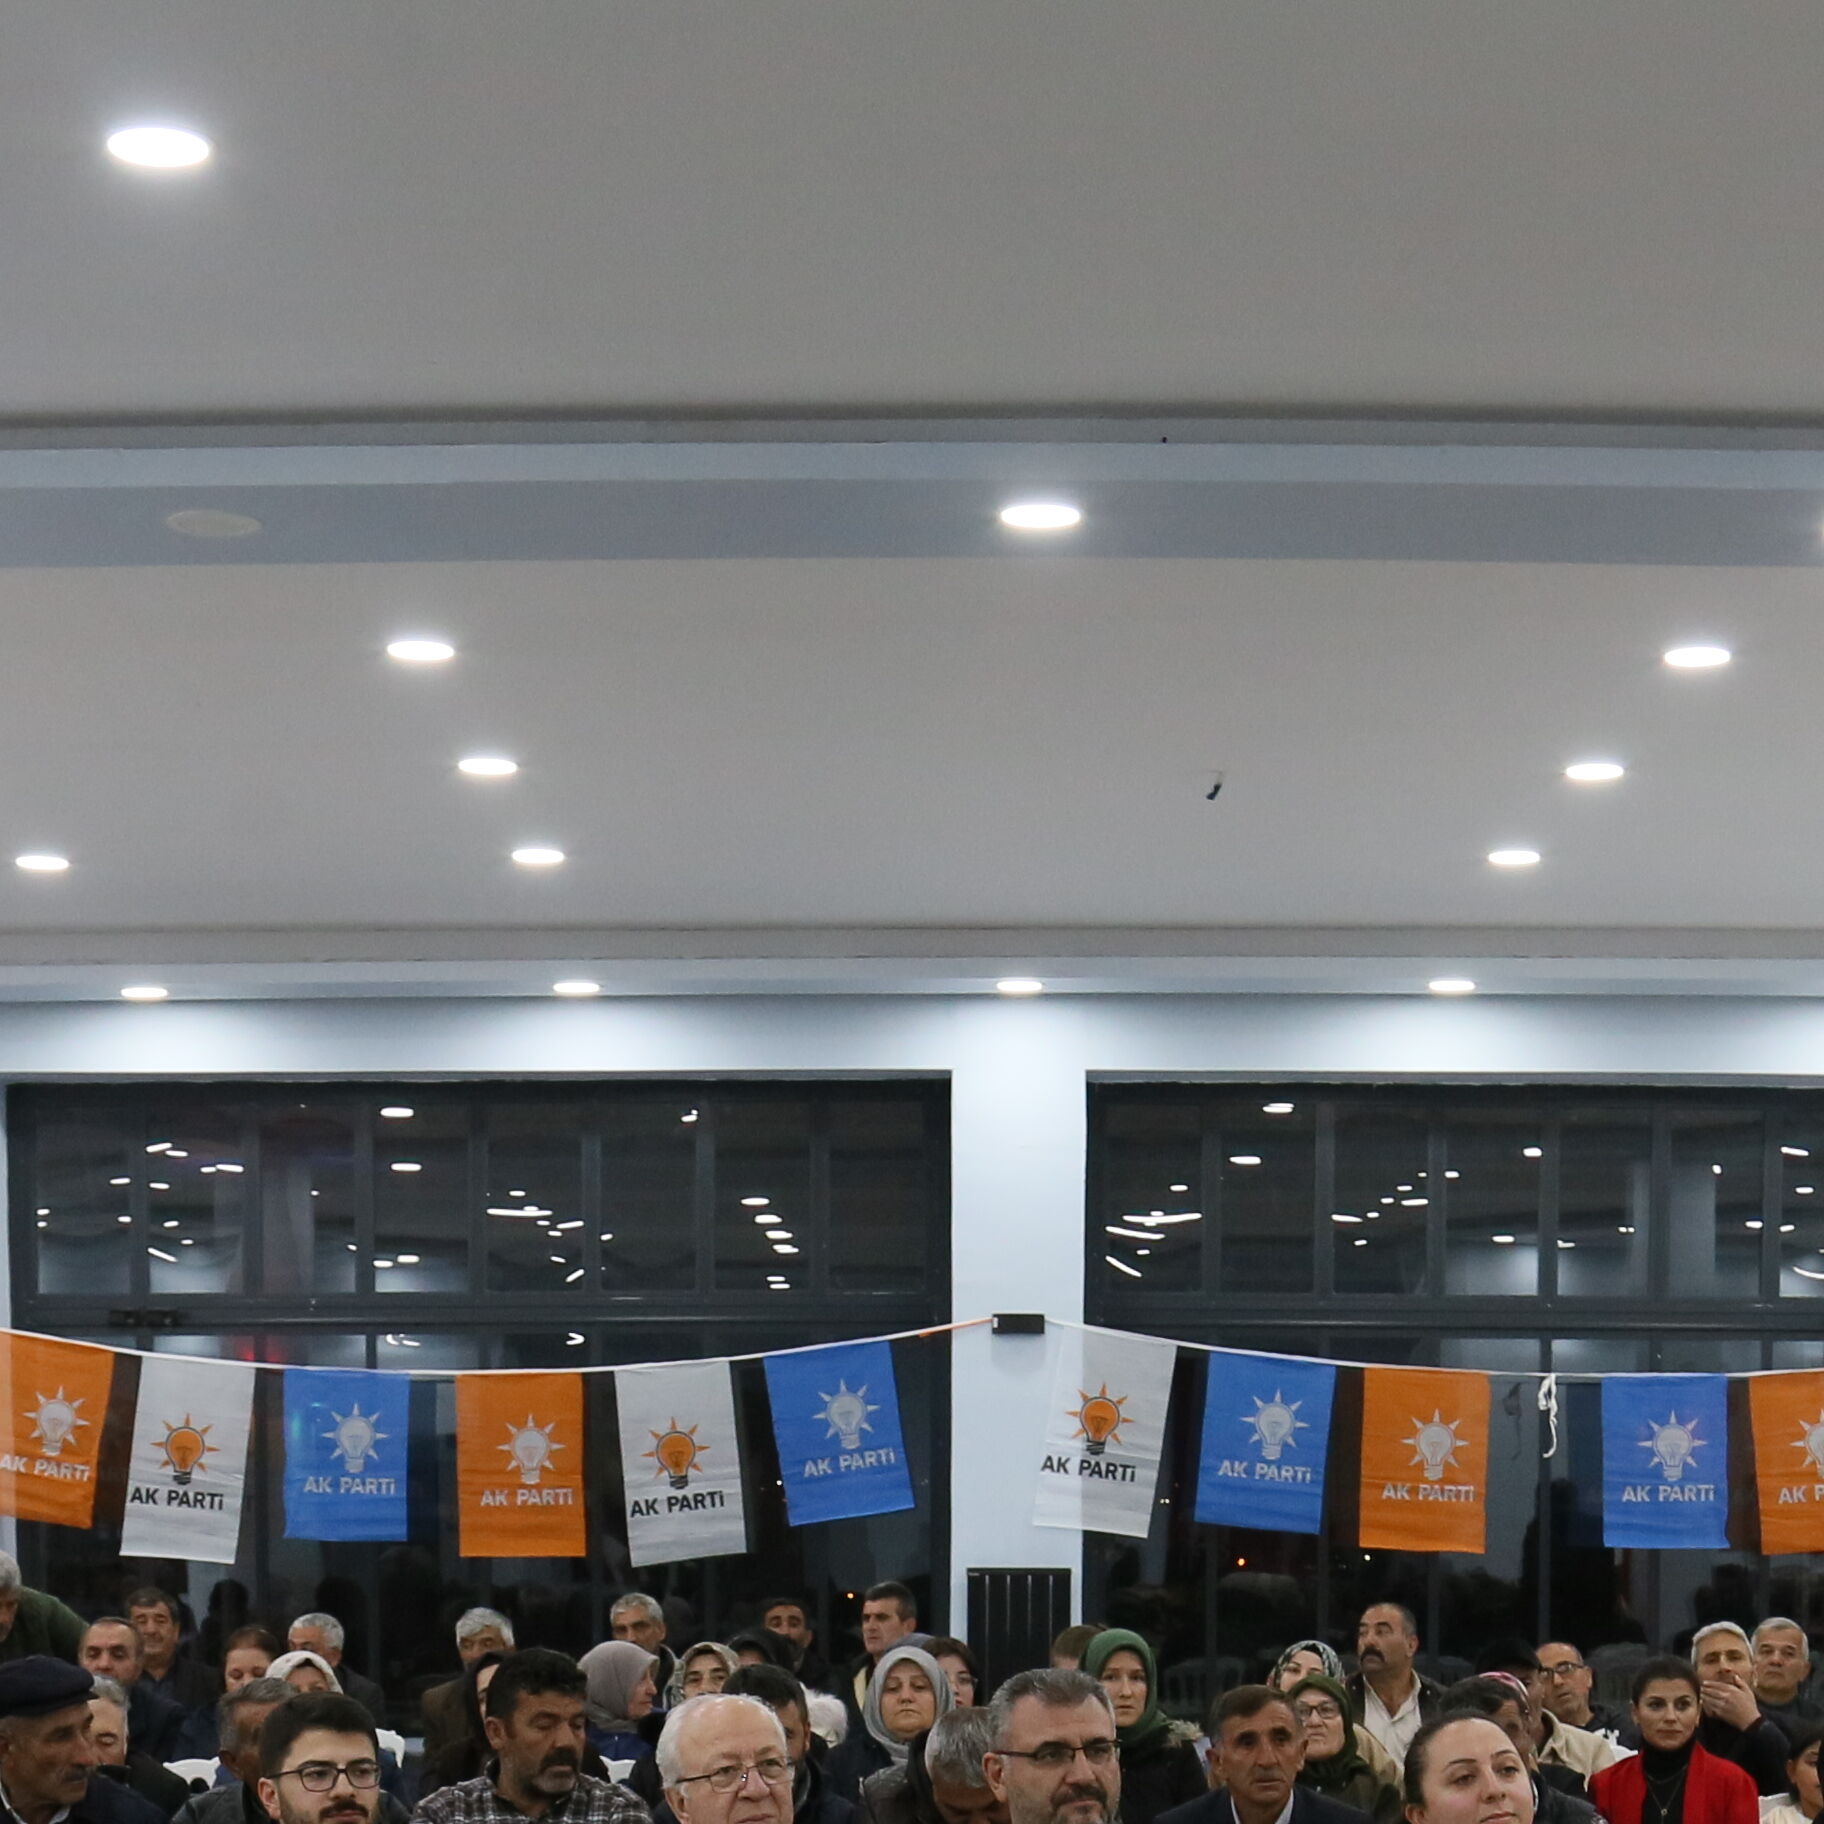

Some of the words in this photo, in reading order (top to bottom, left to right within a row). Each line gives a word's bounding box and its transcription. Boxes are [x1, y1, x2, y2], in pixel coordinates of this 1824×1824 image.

[803, 1457, 832, 1479] AK
[1041, 1454, 1069, 1476] AK
[1218, 1460, 1247, 1479] AK
[303, 1476, 331, 1494] AK
[1381, 1484, 1410, 1501] AK
[1621, 1485, 1651, 1503] AK
[130, 1488, 159, 1506] AK
[480, 1489, 508, 1507] AK
[1778, 1485, 1807, 1504] AK
[630, 1498, 659, 1518] AK
